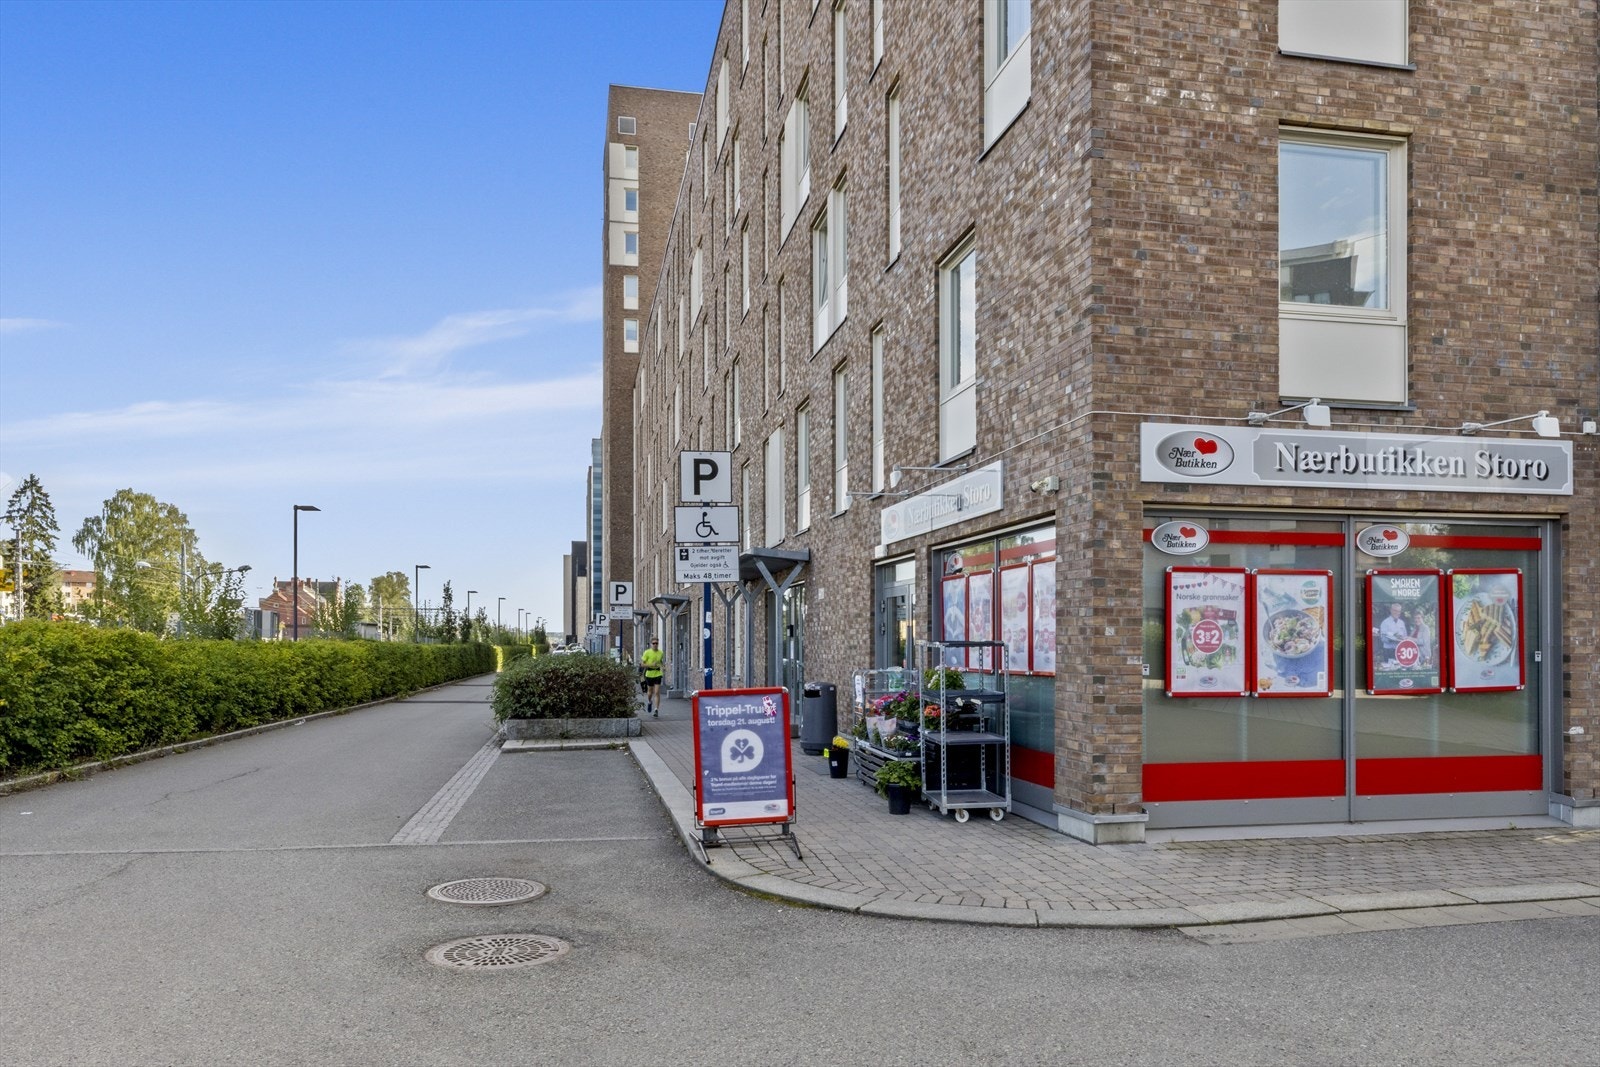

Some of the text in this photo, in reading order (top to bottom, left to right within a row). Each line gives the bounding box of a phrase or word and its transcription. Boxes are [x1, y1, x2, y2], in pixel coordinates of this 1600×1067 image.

[1168, 446, 1197, 459] Nær
[1174, 457, 1218, 470] Butikken
[1274, 441, 1550, 481] Nærbutikken Storo
[694, 458, 718, 495] P
[964, 482, 992, 508] Storo
[1162, 532, 1182, 542] Nær
[1366, 536, 1385, 544] Nær
[1166, 540, 1197, 548] Butikken
[1390, 578, 1420, 588] SMAKEN
[616, 585, 627, 601] P
[599, 615, 606, 624] P
[1196, 630, 1205, 644] 3
[1211, 630, 1219, 644] 2
[707, 719, 736, 727] torsdag
[748, 717, 776, 726] august!
